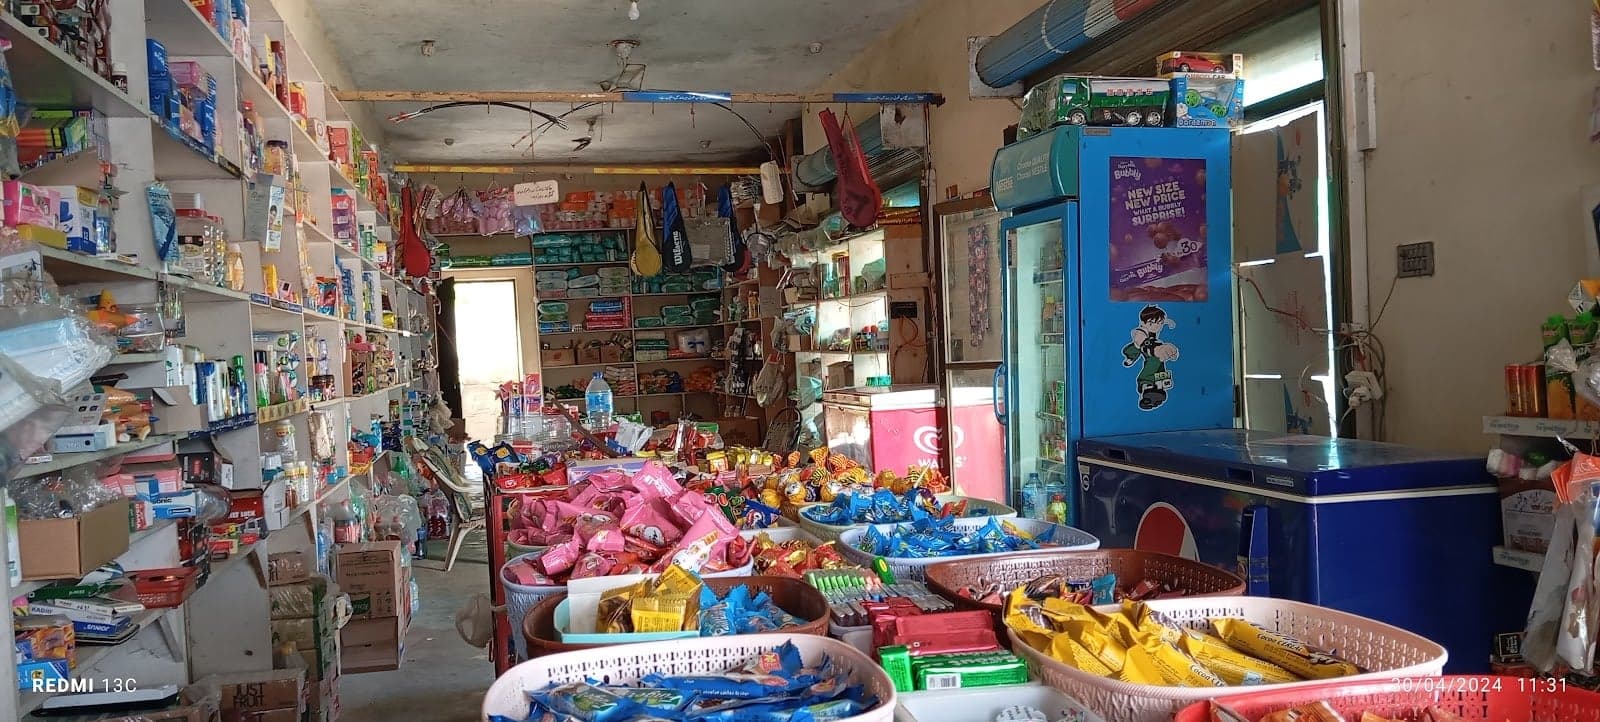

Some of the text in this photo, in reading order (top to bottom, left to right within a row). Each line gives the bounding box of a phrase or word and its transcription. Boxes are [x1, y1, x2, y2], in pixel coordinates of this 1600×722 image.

[1114, 168, 1141, 181] Bubbly
[1127, 181, 1180, 200] NEW SIZE
[1125, 190, 1186, 210] NEW PRICE
[1131, 206, 1186, 226] SURPRISE!
[1133, 207, 1151, 216] WHAT
[1181, 241, 1198, 254] 30
[1136, 262, 1163, 279] Bubbly
[236, 682, 264, 696] JUST
[233, 696, 264, 707] FRUIT
